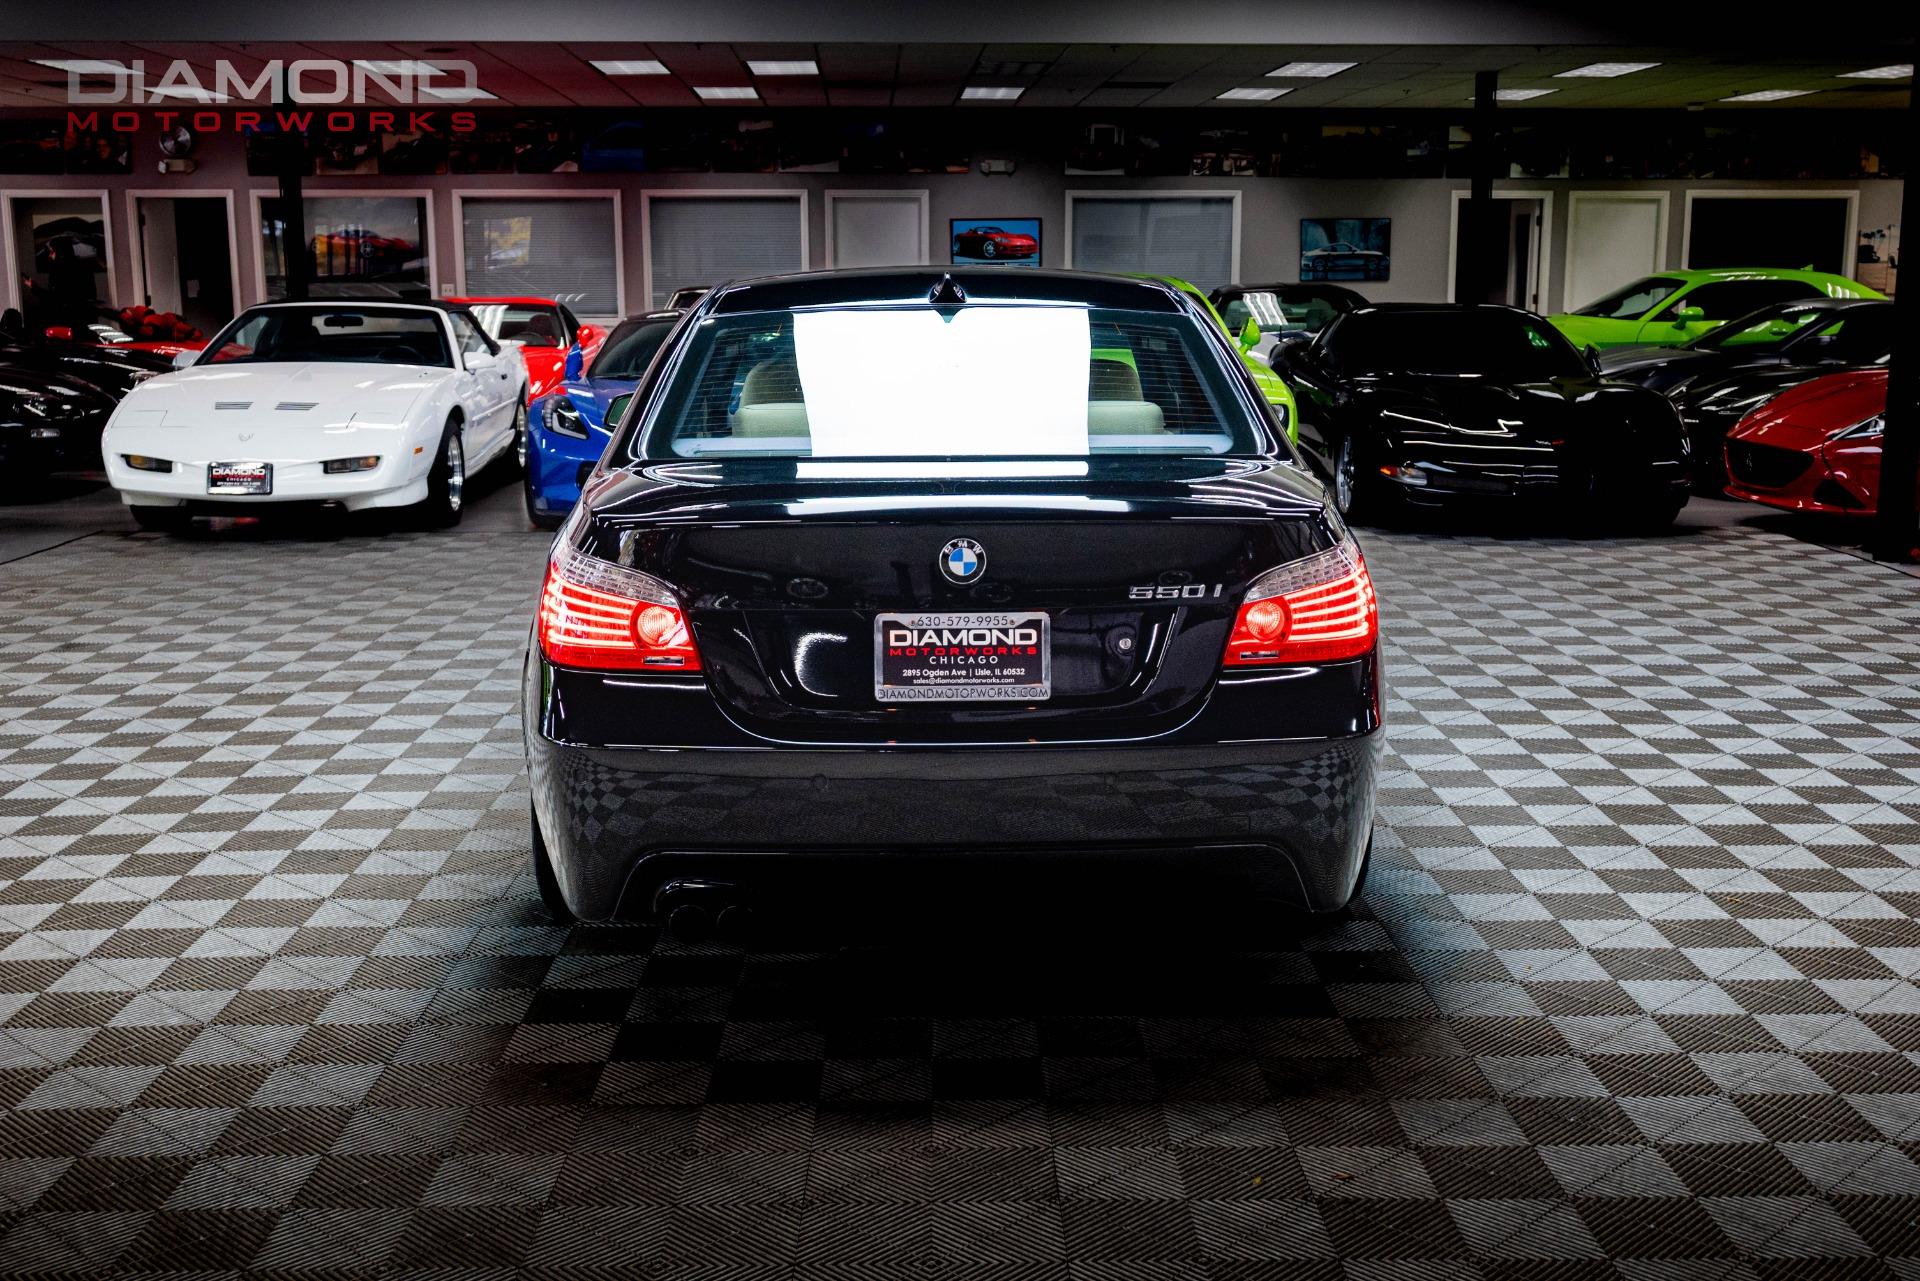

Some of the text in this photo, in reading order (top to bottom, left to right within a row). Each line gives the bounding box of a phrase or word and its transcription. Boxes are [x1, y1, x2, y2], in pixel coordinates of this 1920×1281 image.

[944, 540, 983, 554] BMW
[917, 615, 1009, 627] 630-579-9955
[889, 628, 1038, 647] DIAMOND
[889, 646, 1038, 657] MOTORWORKS
[929, 655, 999, 665] CHICAGO
[902, 669, 921, 677] 2895
[922, 668, 950, 678] Ogden
[951, 668, 967, 677] Ave
[995, 668, 1002, 676] IL
[1002, 667, 1026, 676] 60532
[913, 677, 1015, 685] sales@diamondmotorworks.com
